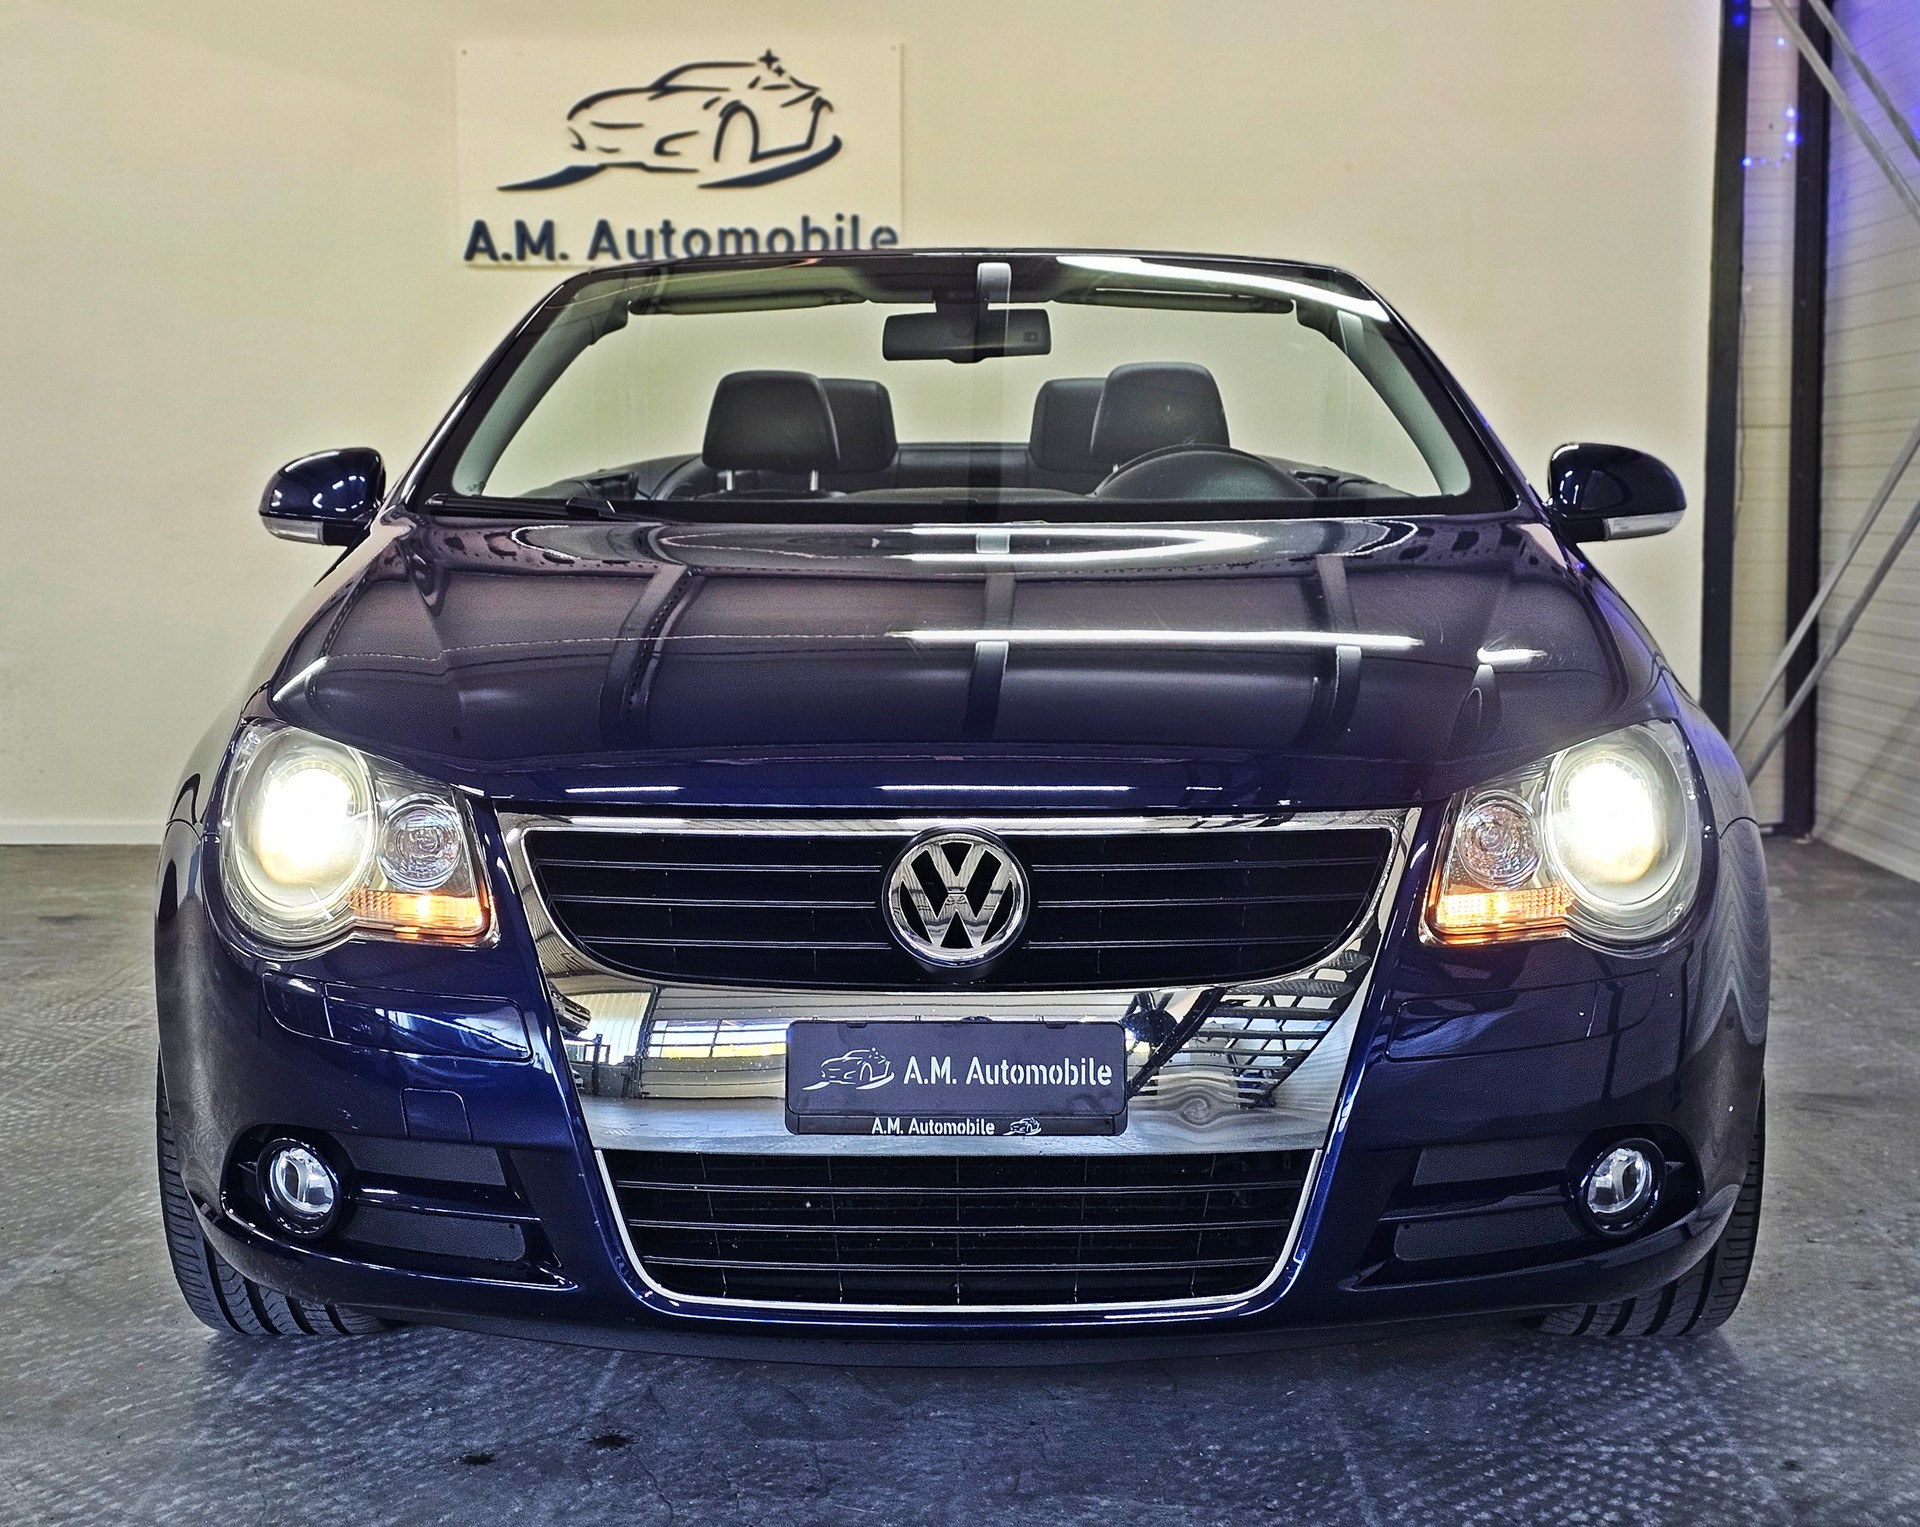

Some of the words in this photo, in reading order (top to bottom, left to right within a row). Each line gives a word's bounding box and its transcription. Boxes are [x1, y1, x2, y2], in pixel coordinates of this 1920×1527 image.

[463, 218, 570, 262] A.M.
[587, 212, 900, 262] Automobile
[889, 833, 1025, 961] VW
[903, 1055, 957, 1086] A.M.
[965, 1055, 1113, 1087] Automobile
[871, 1116, 904, 1135] A.M.
[908, 1116, 996, 1136] Automobile
